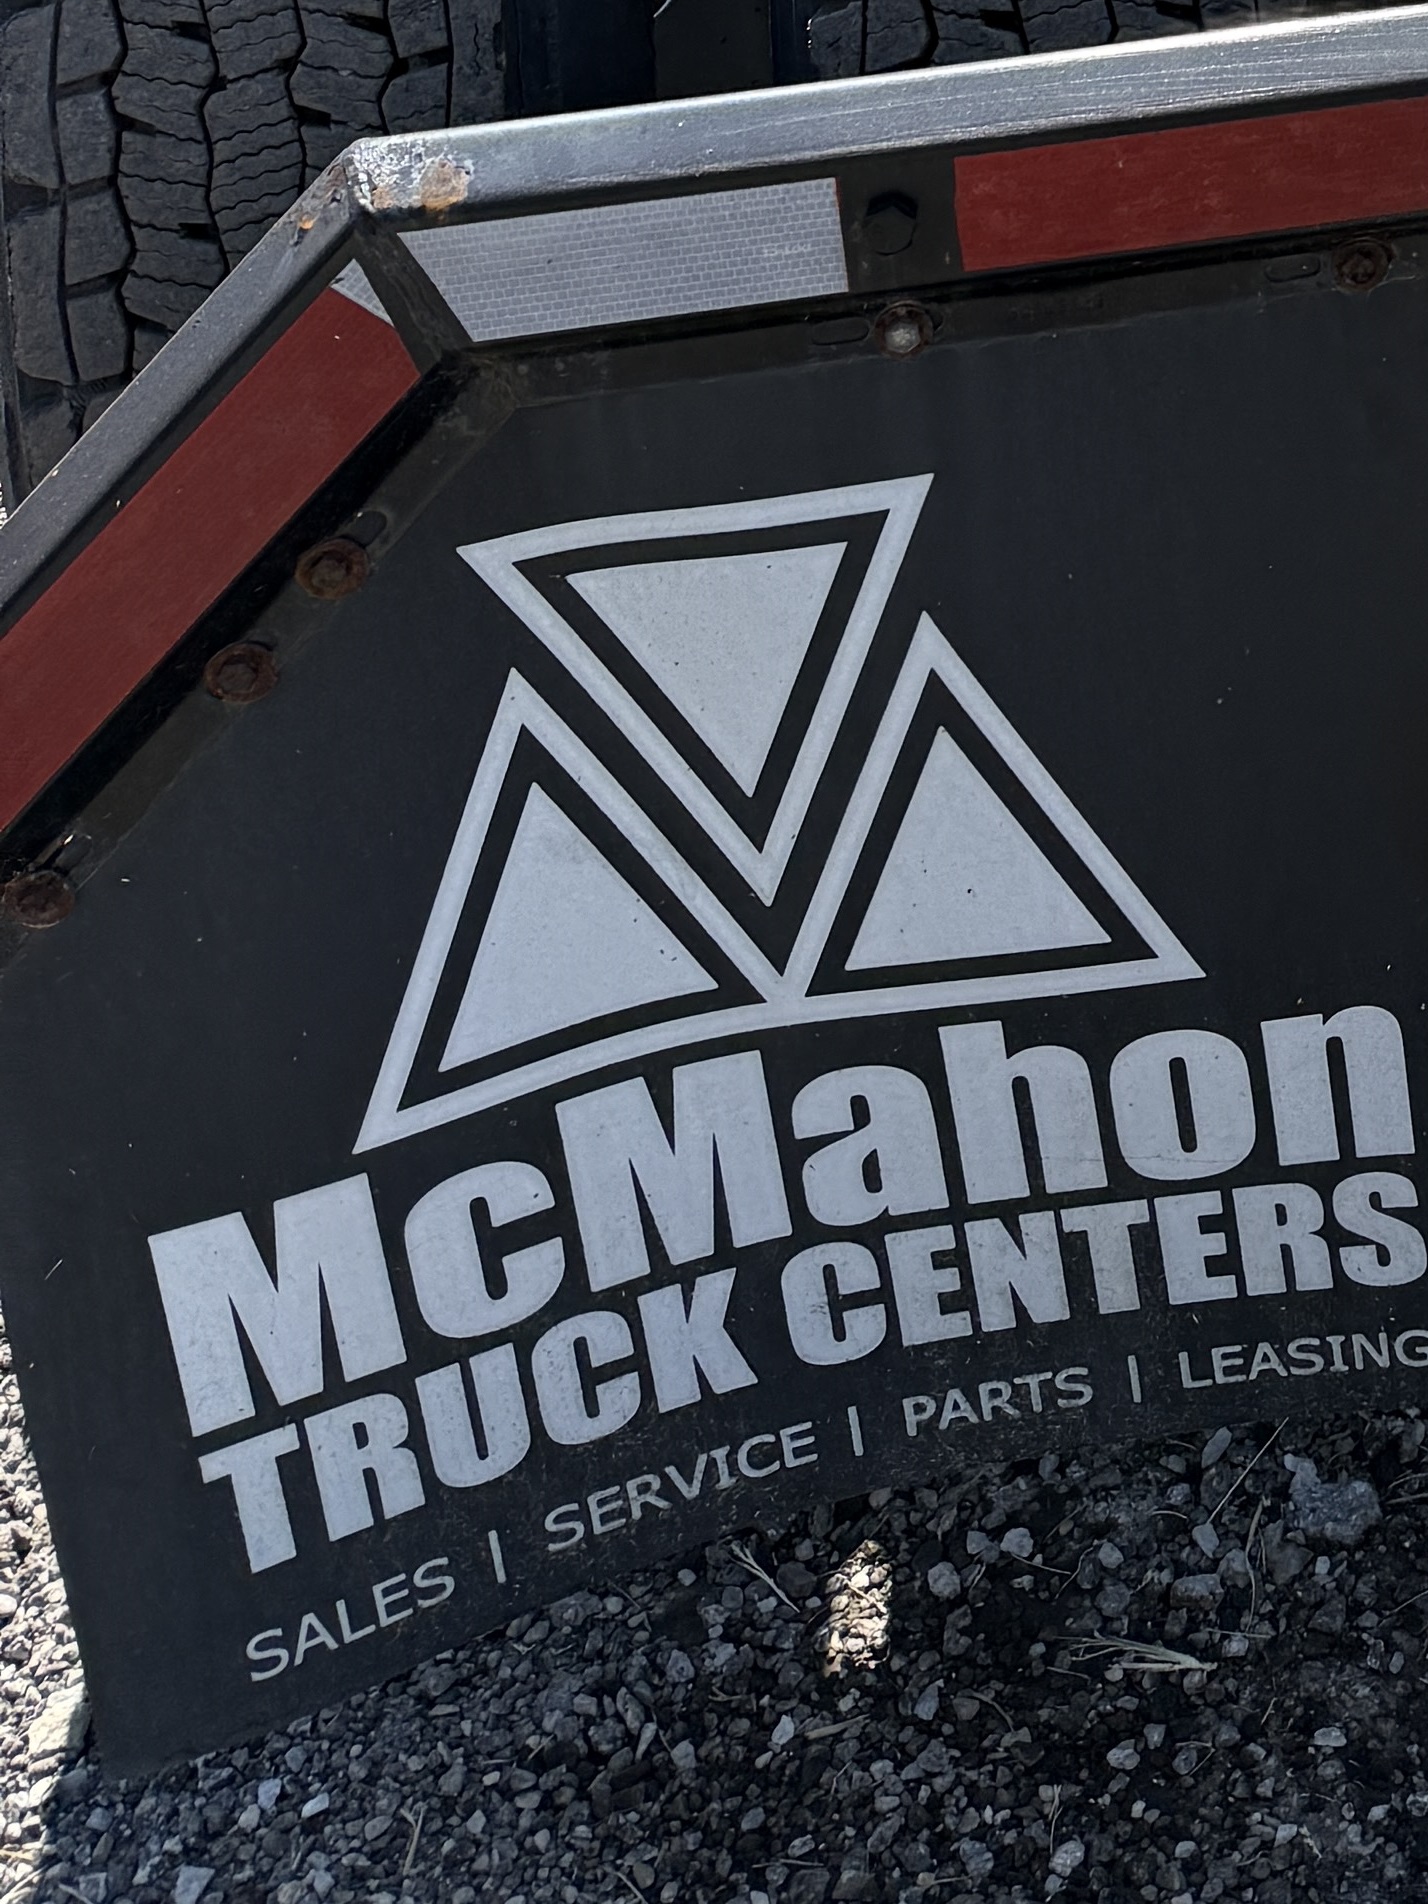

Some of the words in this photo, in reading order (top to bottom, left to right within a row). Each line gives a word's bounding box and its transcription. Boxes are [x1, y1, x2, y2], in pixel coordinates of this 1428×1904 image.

[147, 1005, 1417, 1438] McMahon
[198, 1281, 759, 1574] TRUCK
[780, 1171, 1428, 1366] CENTERS
[246, 1557, 455, 1682] SALES
[544, 1420, 818, 1552] SERVICE
[902, 1366, 1094, 1438] PARTS
